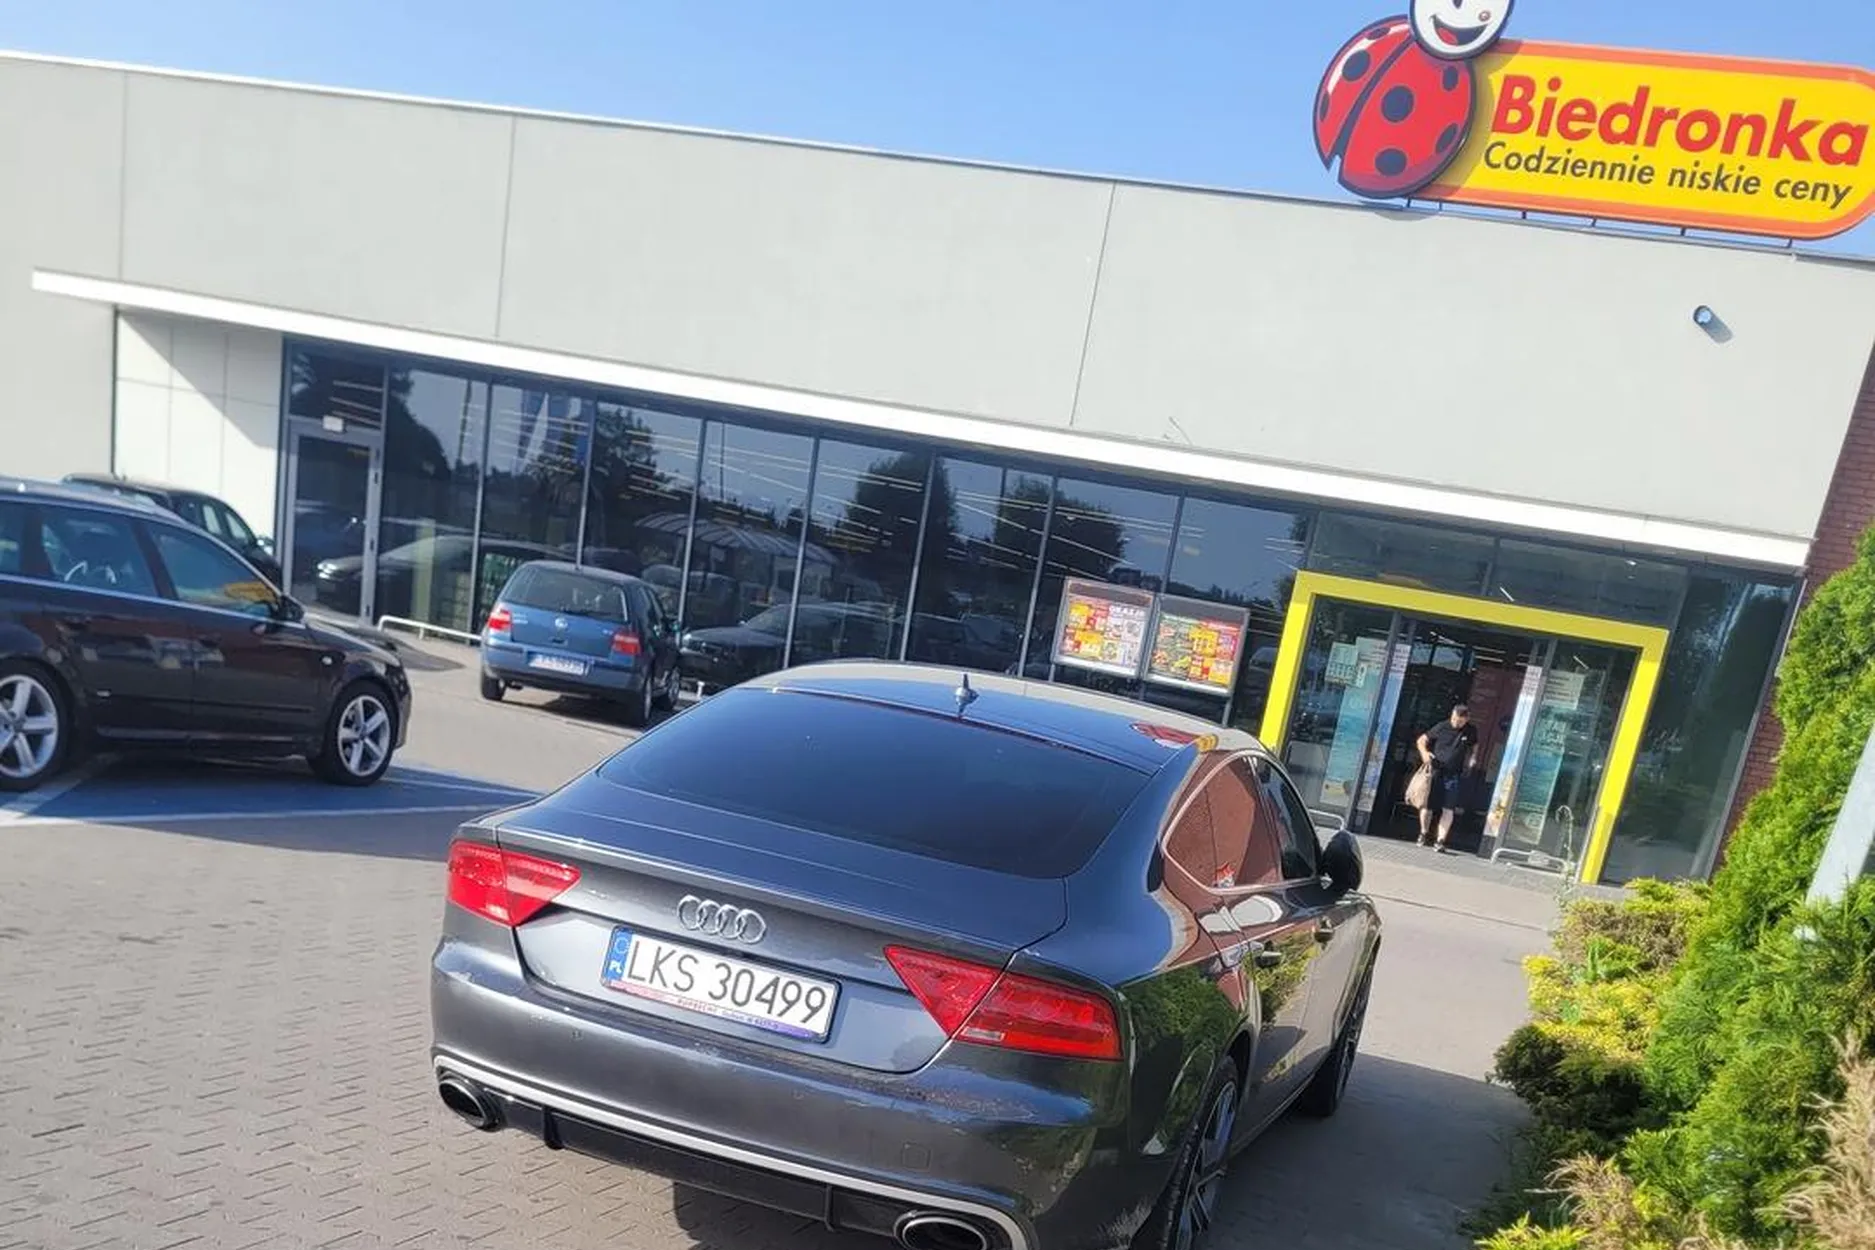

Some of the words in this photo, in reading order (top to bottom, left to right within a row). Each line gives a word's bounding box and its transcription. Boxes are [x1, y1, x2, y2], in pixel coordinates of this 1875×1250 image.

[1491, 74, 1869, 167] Biedronka
[1484, 142, 1655, 185] Codziennie
[1668, 160, 1762, 196] niskie
[1774, 177, 1853, 209] ceny
[609, 961, 623, 975] PL
[627, 940, 699, 992] LKS
[708, 963, 827, 1024] 30499
